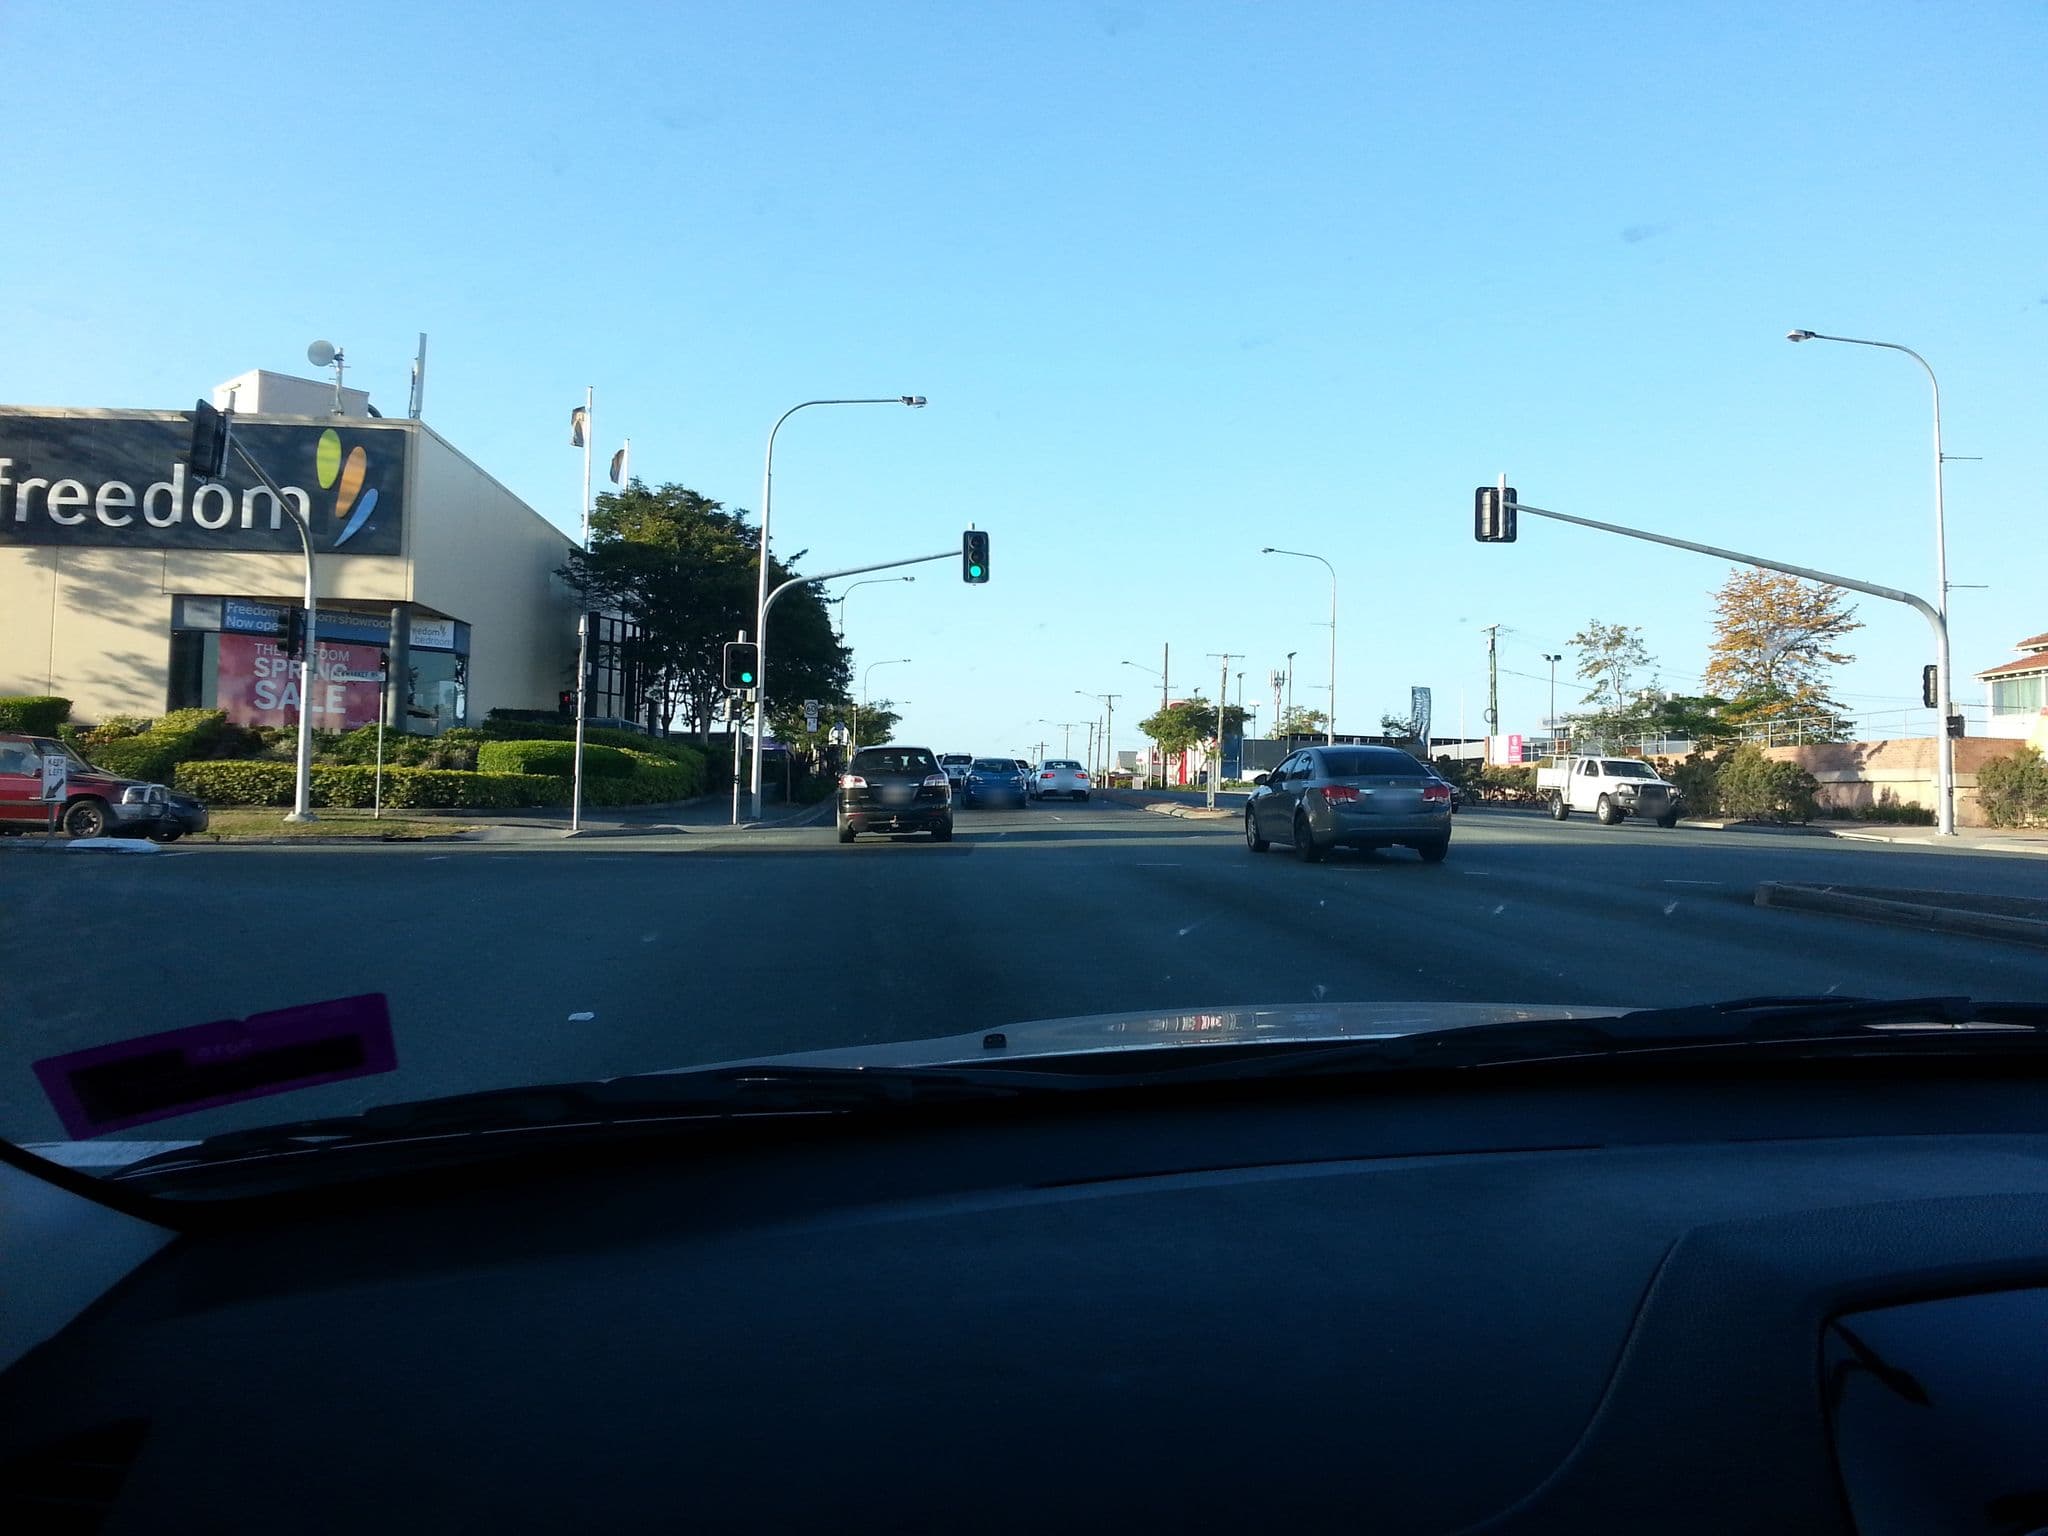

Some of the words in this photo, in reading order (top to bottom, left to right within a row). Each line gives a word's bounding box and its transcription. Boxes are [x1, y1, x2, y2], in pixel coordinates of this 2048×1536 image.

[0, 458, 310, 530] freedom
[226, 602, 280, 617] Freedom
[225, 614, 255, 629] Now
[256, 618, 279, 632] ope
[255, 642, 282, 657] THE
[254, 656, 348, 683] SPRNG
[48, 758, 64, 766] KEEP
[48, 768, 63, 776] LEFT
